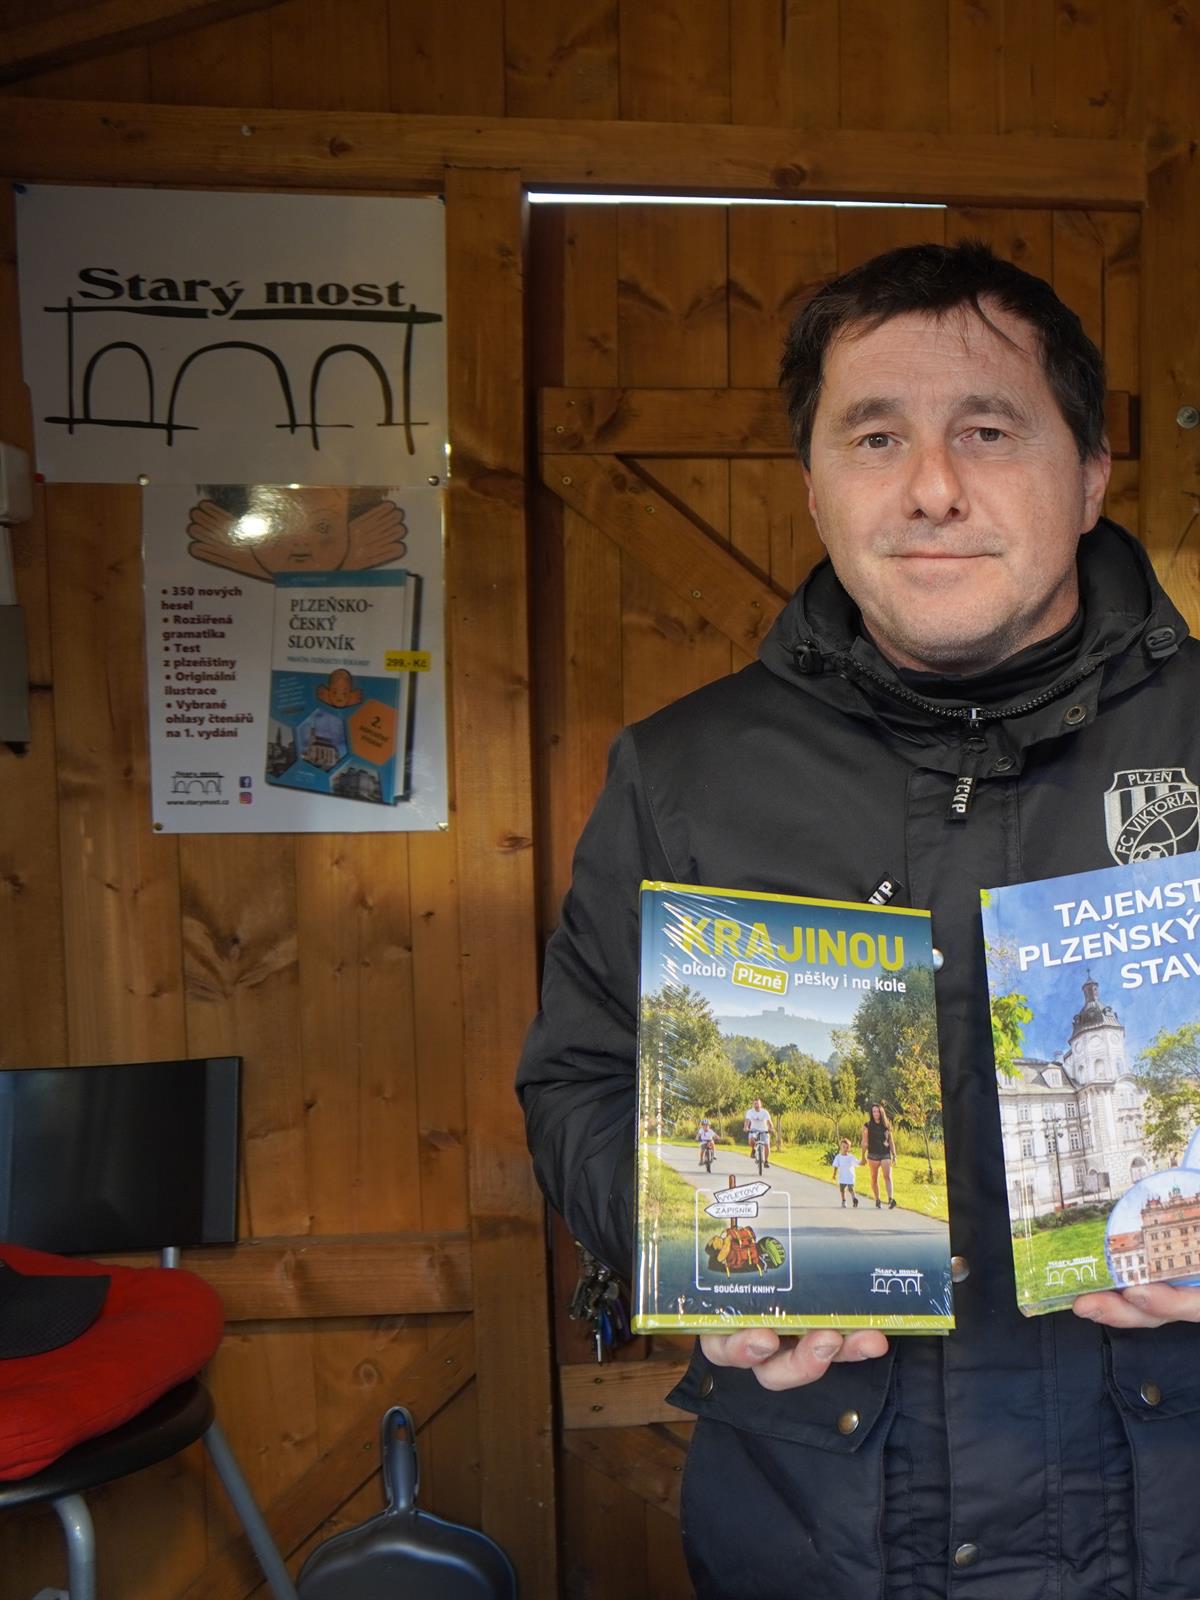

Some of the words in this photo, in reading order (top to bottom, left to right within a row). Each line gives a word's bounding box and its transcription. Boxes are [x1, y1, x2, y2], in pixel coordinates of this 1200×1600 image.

[78, 267, 244, 316] Starý
[264, 280, 409, 307] most
[171, 586, 195, 597] 350
[198, 586, 242, 599] nových
[161, 600, 193, 610] hesel
[290, 597, 373, 613] PLZEŇSKO-
[289, 614, 337, 631] ČESKÝ
[162, 630, 225, 641] gramatika
[174, 643, 201, 653] Test
[288, 634, 356, 651] SLOVNÍK
[163, 659, 170, 667] z
[175, 672, 236, 683] Originální
[164, 686, 217, 696] ilustrace
[176, 699, 227, 711] Vybrané
[166, 714, 205, 726] ohlasy
[166, 729, 181, 738] na
[198, 728, 238, 740] vydání
[952, 777, 973, 813] FCVP
[1117, 835, 1134, 855] FC
[1127, 792, 1194, 832] VIKTORIA
[682, 915, 904, 971] KRAJINOU
[682, 961, 726, 978] okolo
[737, 967, 783, 990] Plzně
[794, 971, 839, 991] pěšky
[843, 974, 848, 987] i
[852, 978, 871, 990] na
[875, 976, 906, 993] kole
[752, 1284, 776, 1294] KNIHY
